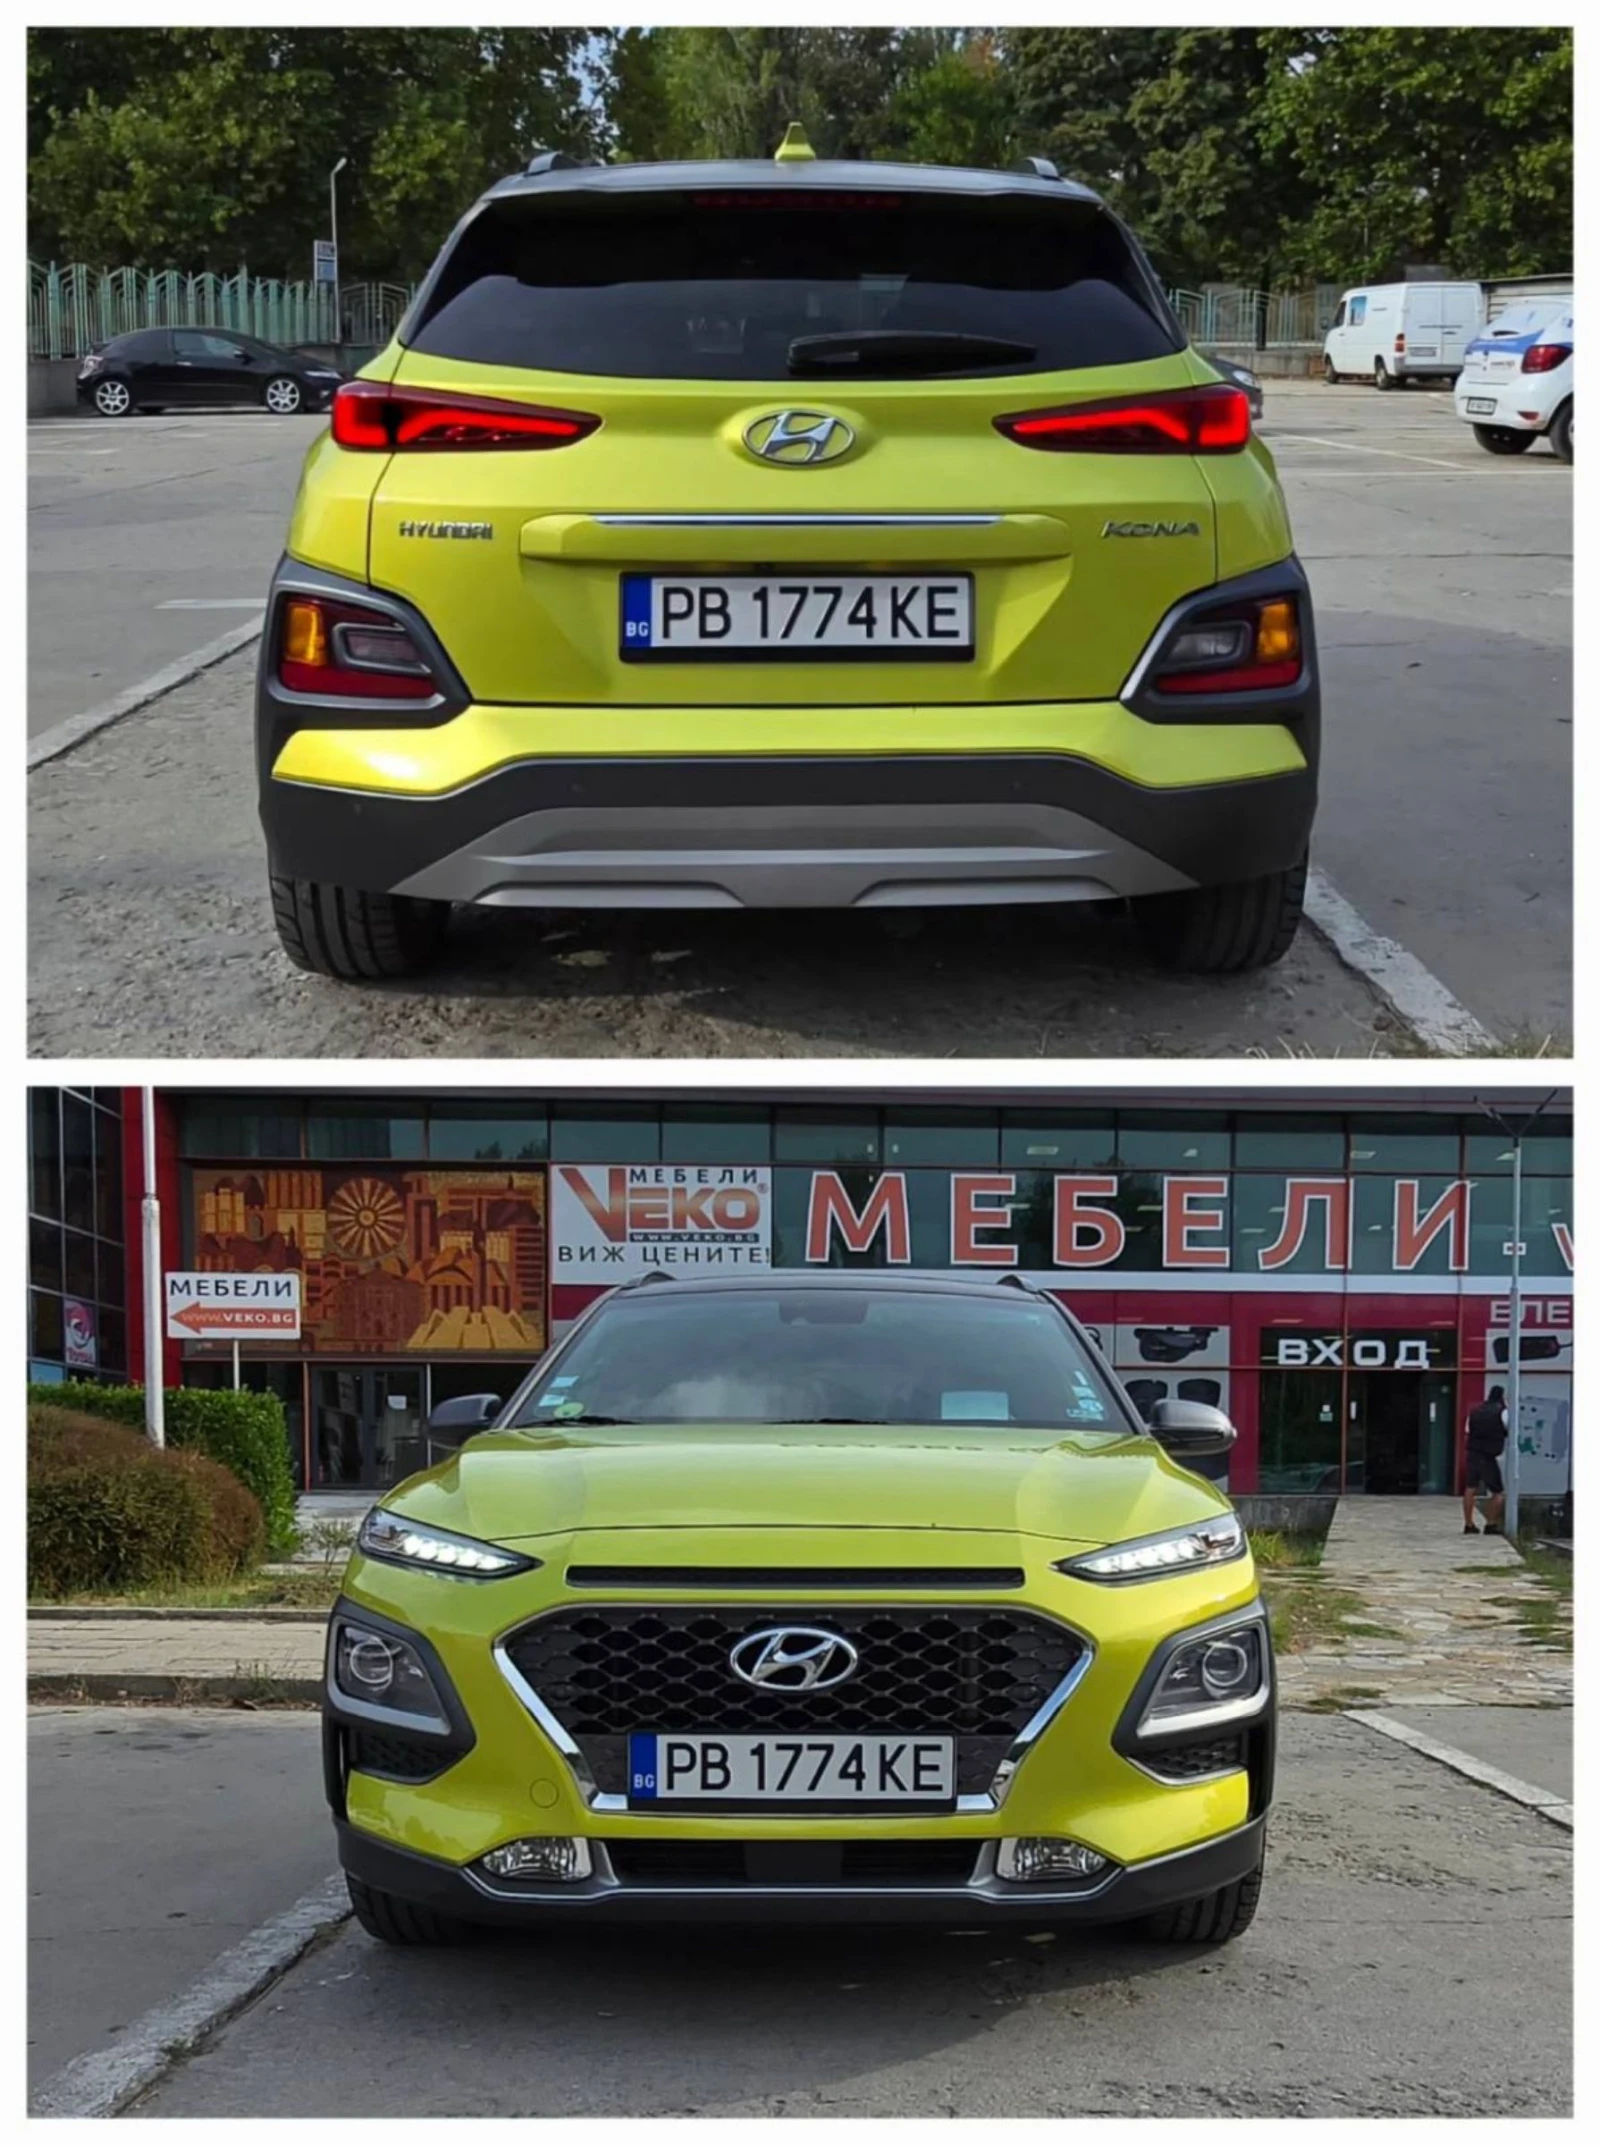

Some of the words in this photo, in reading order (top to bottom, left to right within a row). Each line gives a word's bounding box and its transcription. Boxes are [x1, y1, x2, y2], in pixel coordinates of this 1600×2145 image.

[399, 520, 493, 540] HYUNDAI
[1101, 521, 1200, 538] KONA
[662, 586, 731, 639] PB
[752, 586, 877, 639] 1774
[890, 586, 960, 639] KE
[625, 621, 649, 637] BG
[629, 1168, 758, 1184] МЕБЕЛИ
[559, 1168, 760, 1242] VEKO
[805, 1170, 1471, 1271] МЕБЕЛИ
[558, 1246, 625, 1263] ВИЖ
[642, 1246, 771, 1267] ЦЕНИТЕ!
[170, 1279, 292, 1297] МЕБЕЛИ
[1278, 1339, 1430, 1370] ВХОД
[666, 1742, 731, 1791] PB
[750, 1743, 866, 1792] 1774
[879, 1744, 944, 1792] KE
[633, 1773, 655, 1789] BG
